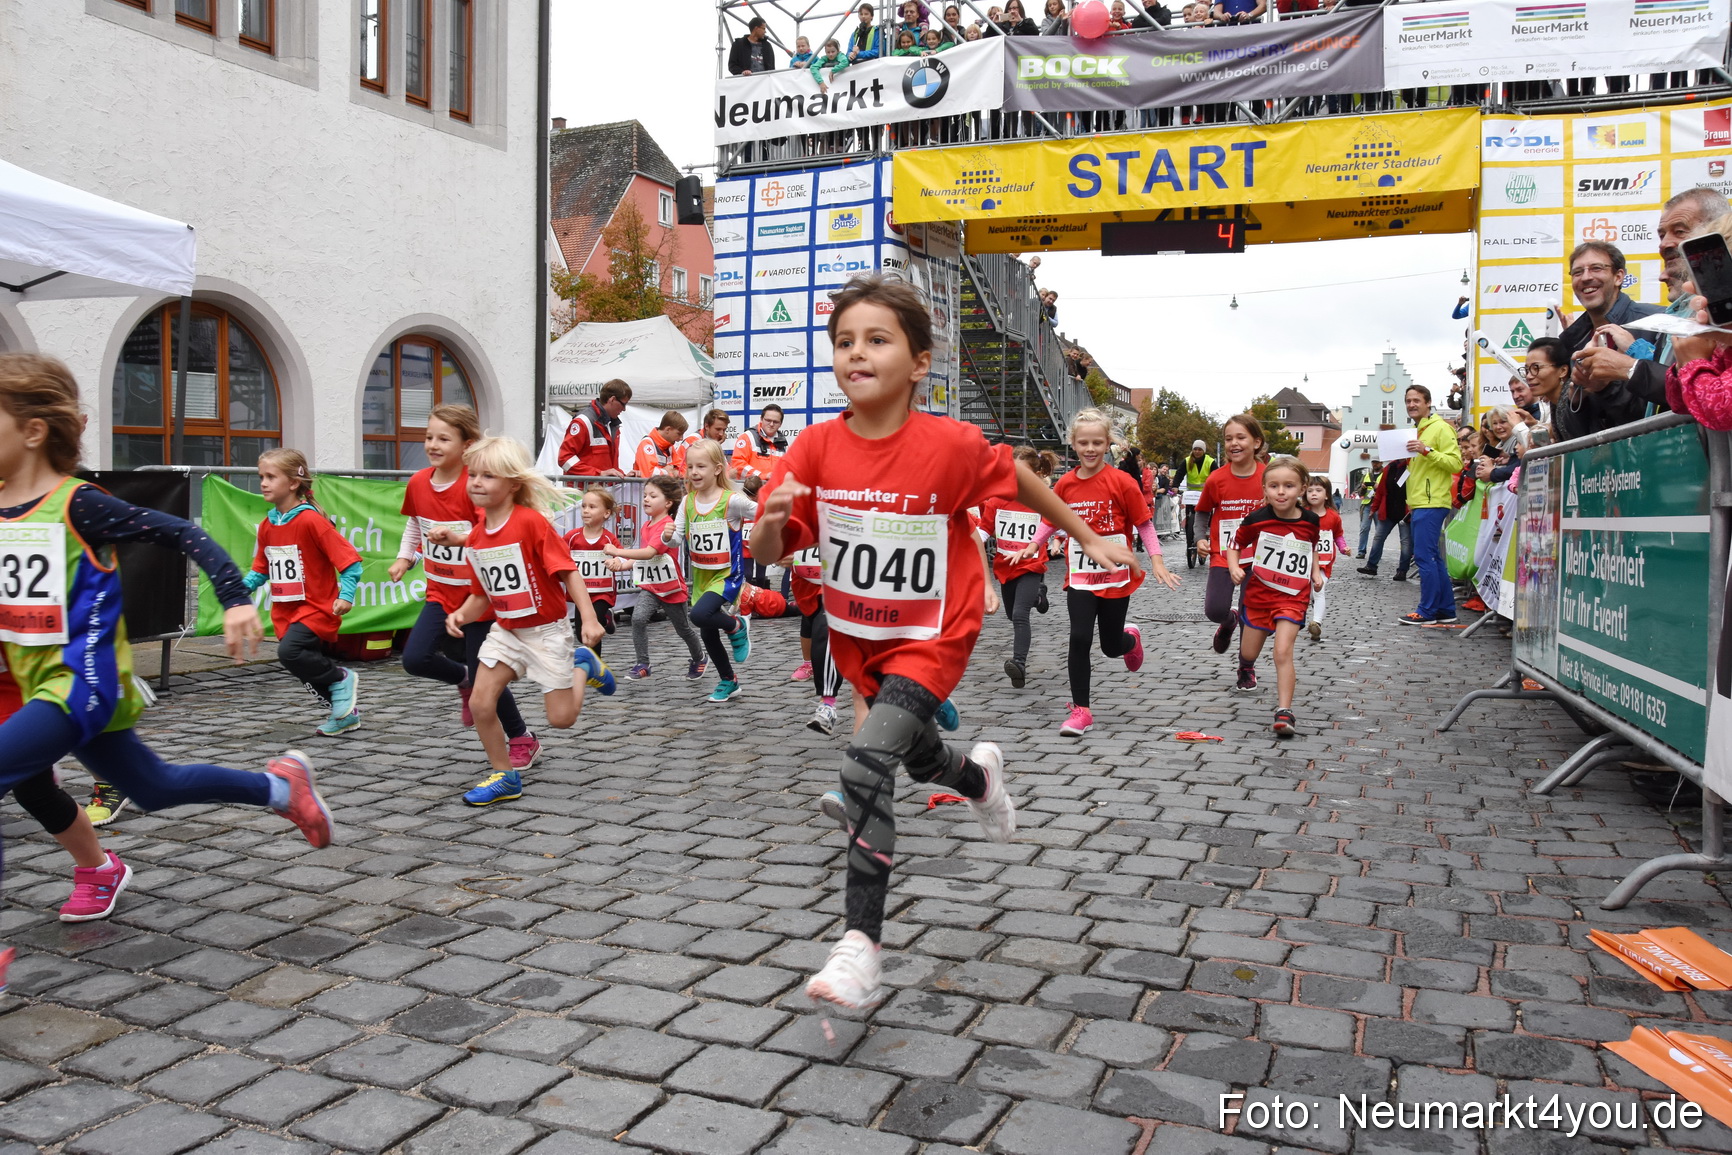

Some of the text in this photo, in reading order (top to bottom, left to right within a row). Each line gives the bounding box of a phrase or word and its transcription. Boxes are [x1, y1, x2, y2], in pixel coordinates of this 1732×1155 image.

[1511, 21, 1589, 35] NeuerMarkt
[1629, 11, 1713, 28] NeuerMarkt
[1398, 29, 1473, 43] NeuerMarkt
[1151, 35, 1361, 67] OFFICE INDUSTRY LOUNGE
[1019, 55, 1127, 79] BOCK
[1180, 58, 1329, 82] www.bockonline.de
[1016, 79, 1130, 91] inspired by smart concepts
[715, 78, 885, 129] Neumarkt
[1704, 130, 1729, 141] Braun
[1524, 146, 1560, 154] energie
[1067, 140, 1266, 198] START
[1305, 155, 1442, 174] Neumarkter Stadtlauf
[786, 184, 805, 192] CODE
[920, 182, 1036, 197] Neumarkter Stadtlauf
[1577, 178, 1629, 192] swn
[714, 195, 746, 203] ARIOTEC
[786, 190, 807, 199] CLINIC
[1326, 202, 1444, 219] Neumarkter Stadtlauf
[987, 222, 1088, 235] Neumarkter Stadtlauf
[1218, 223, 1234, 248] 4
[1621, 224, 1648, 233] CODE
[1621, 232, 1652, 242] CLINIC
[768, 266, 806, 276] VARIOTEC
[720, 280, 743, 288] energie
[1504, 283, 1562, 293] VARIOTEC
[753, 386, 786, 397] swn
[815, 485, 899, 503] Neumarkter
[331, 515, 383, 553] lich
[872, 517, 938, 535] BOCK
[999, 521, 1037, 541] 7419
[690, 532, 724, 552] 257
[1316, 539, 1330, 552] 53
[829, 536, 936, 594] 7040
[1262, 546, 1308, 576] 7139
[1565, 541, 1645, 588] Mehr Sicherheit
[0, 554, 49, 598] 32
[637, 564, 672, 582] 7411
[1272, 574, 1290, 585] Leni
[848, 601, 900, 623] Marie
[1562, 587, 1628, 642] für Ihr Event!
[1560, 654, 1667, 728] Miet & Service Line: 09181 6352
